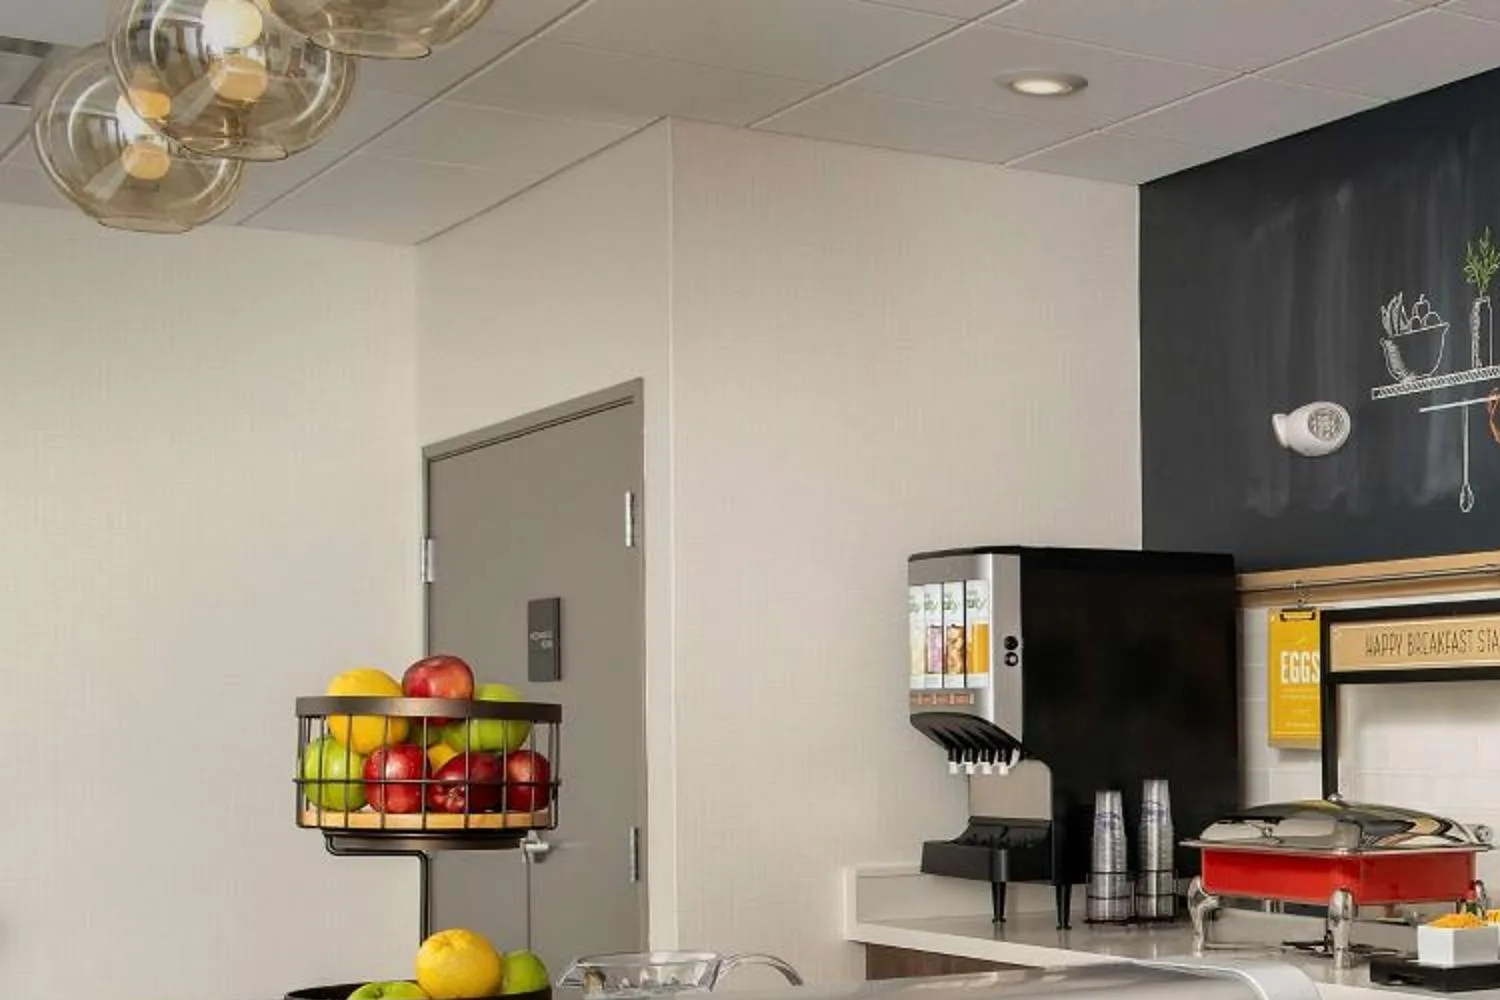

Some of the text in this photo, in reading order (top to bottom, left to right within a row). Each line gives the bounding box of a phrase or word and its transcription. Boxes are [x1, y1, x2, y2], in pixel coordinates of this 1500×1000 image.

[1365, 631, 1403, 657] HAPPY
[1407, 629, 1473, 656] BREAKFAST
[1280, 650, 1320, 684] EGGS
